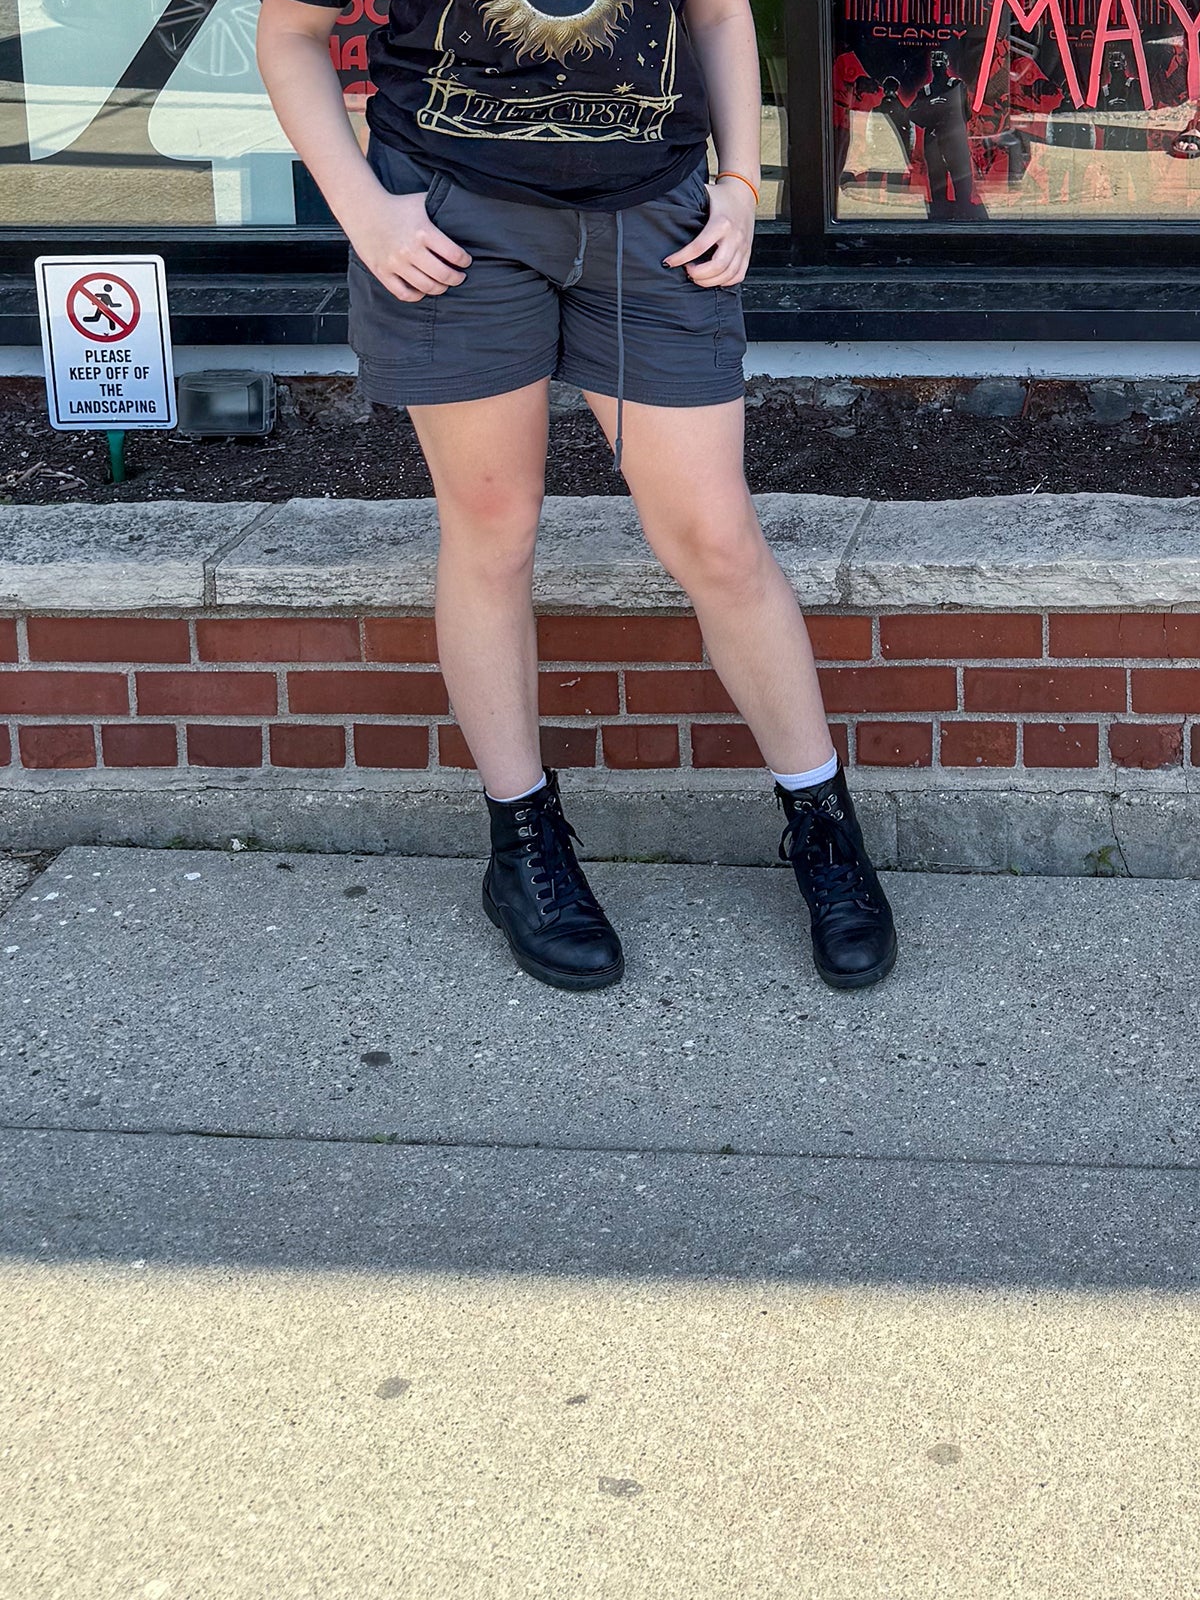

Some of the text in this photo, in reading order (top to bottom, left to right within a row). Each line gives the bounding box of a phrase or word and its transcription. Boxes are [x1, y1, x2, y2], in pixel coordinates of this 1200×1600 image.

[872, 26, 968, 39] CLANCY
[84, 349, 132, 363] PLEASE
[69, 365, 150, 381] KEEP OFF OF
[99, 383, 123, 397] THE
[69, 400, 156, 414] LANDSCAPING
